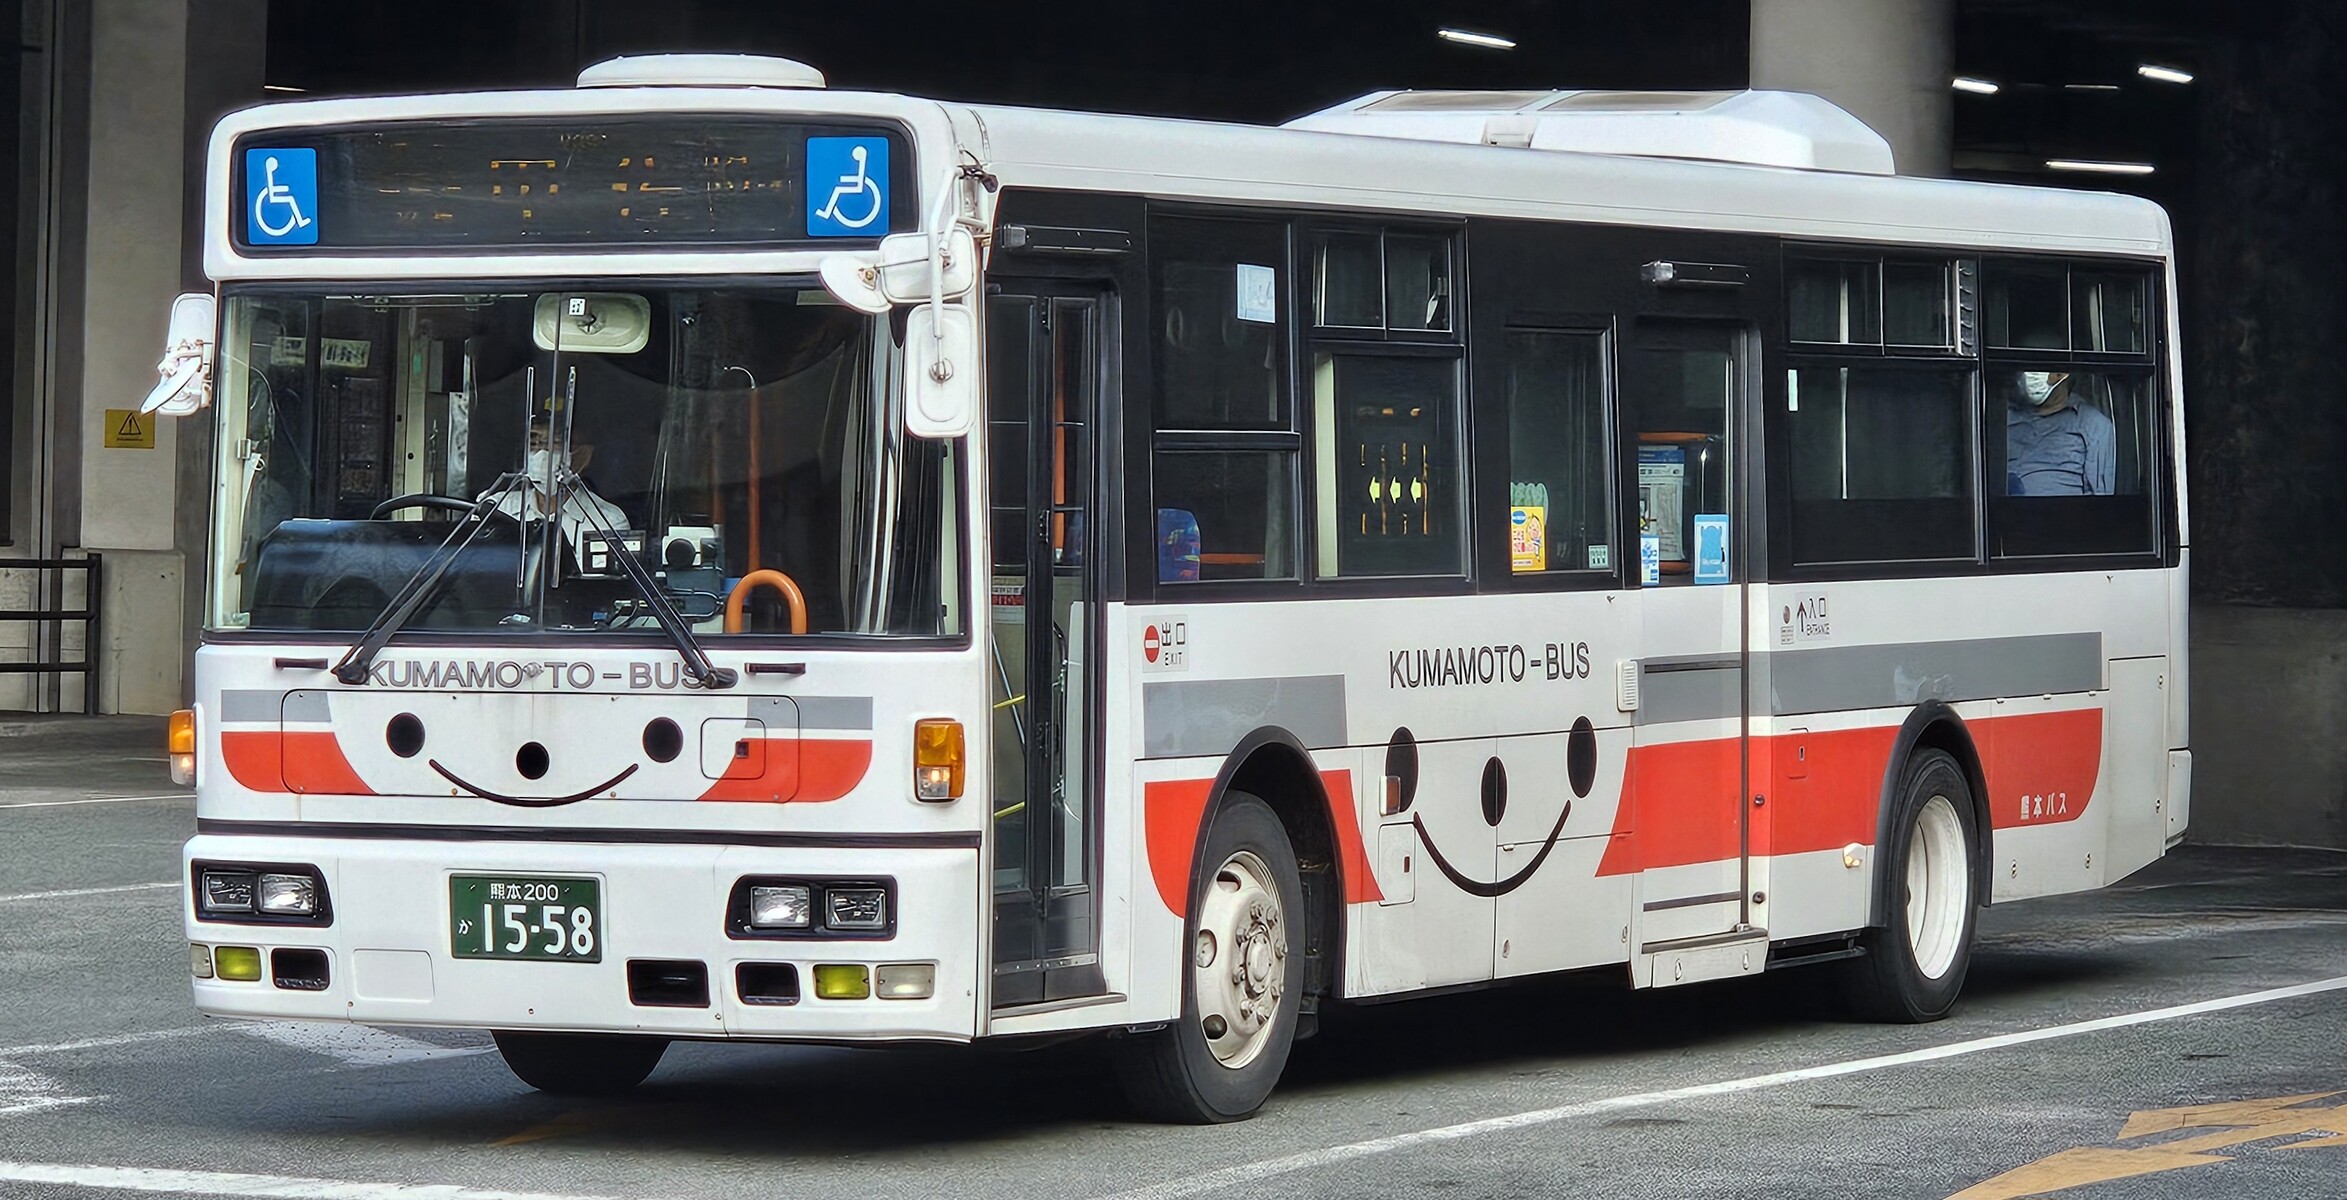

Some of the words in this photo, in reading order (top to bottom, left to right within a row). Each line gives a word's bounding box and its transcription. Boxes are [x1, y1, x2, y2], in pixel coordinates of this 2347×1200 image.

[1808, 597, 1826, 618] 入口
[1161, 621, 1186, 646] 出口
[483, 903, 594, 956] 15-58
